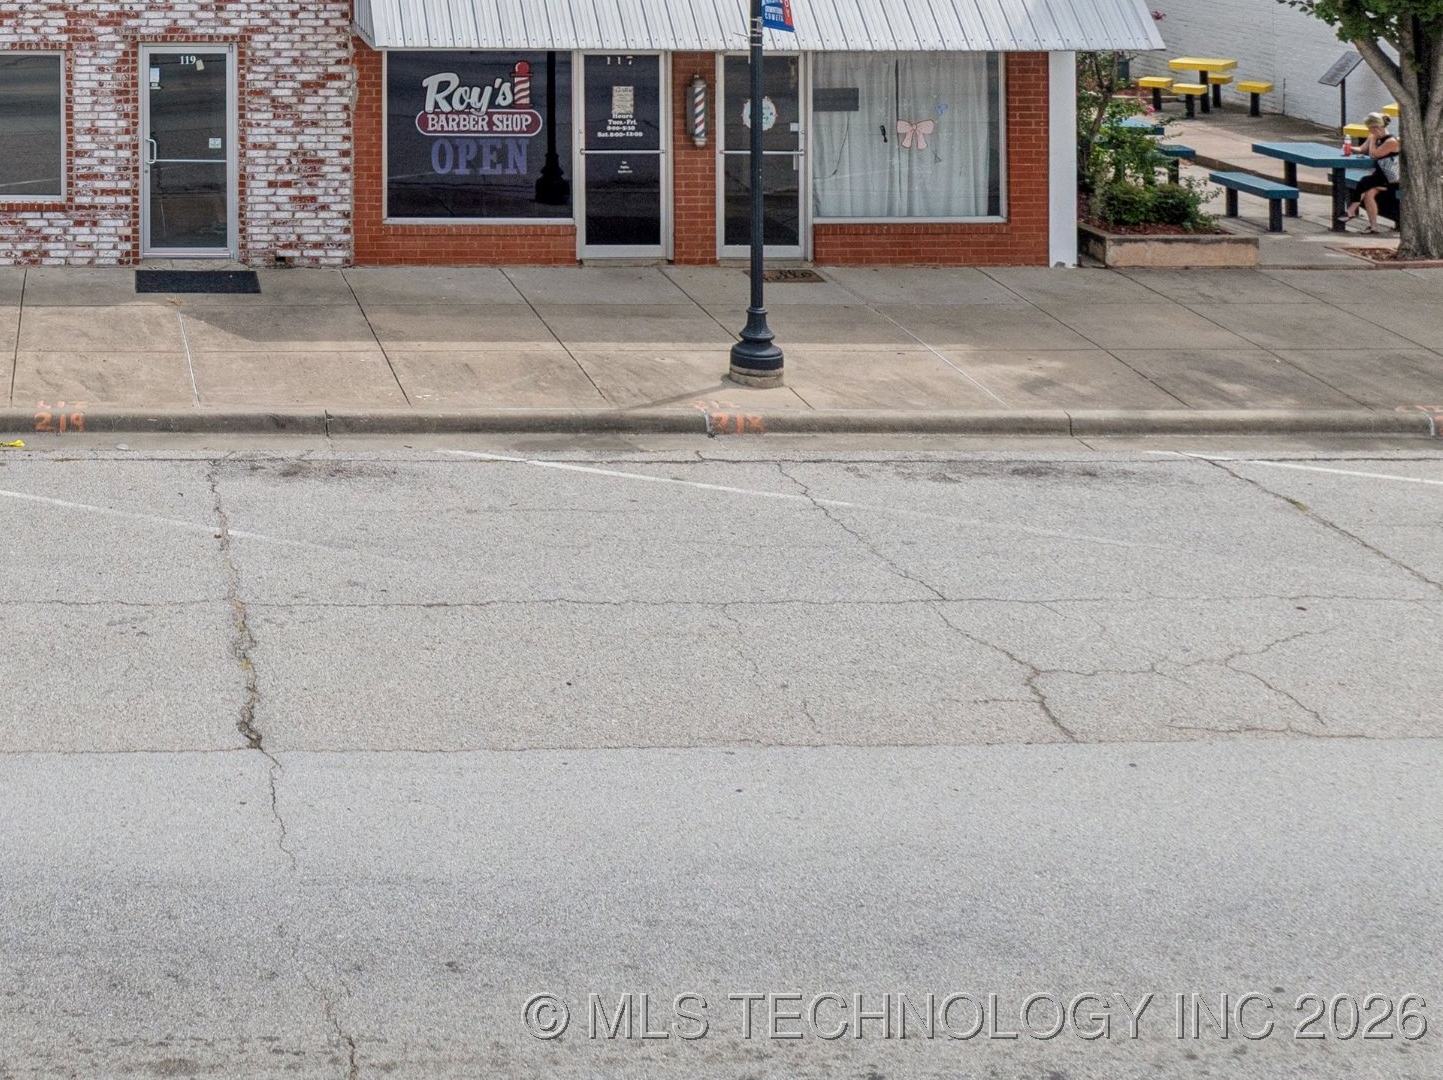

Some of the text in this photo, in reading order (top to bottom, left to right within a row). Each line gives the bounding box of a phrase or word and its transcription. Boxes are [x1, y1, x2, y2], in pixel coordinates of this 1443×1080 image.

[180, 55, 196, 65] 119
[606, 56, 633, 65] 117
[422, 72, 513, 116] Roy's
[426, 113, 532, 132] BARBER SHOP
[431, 138, 529, 175] OPEN
